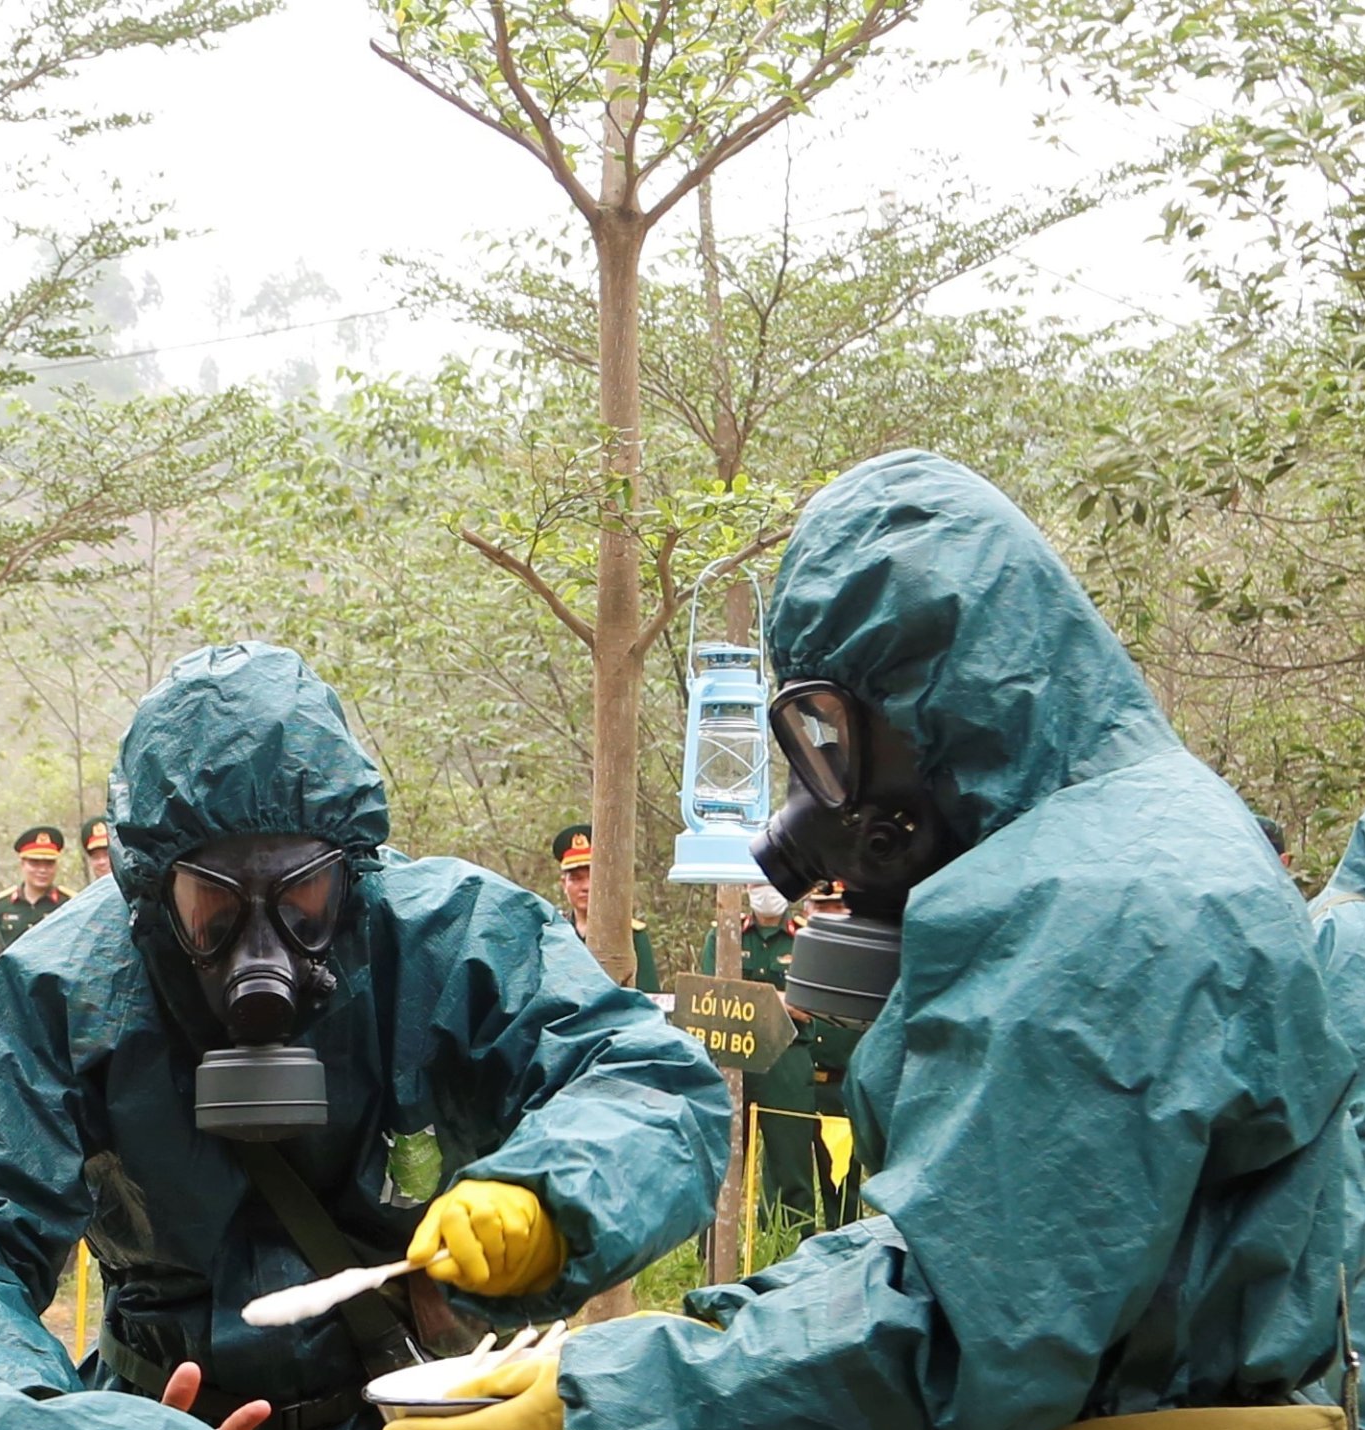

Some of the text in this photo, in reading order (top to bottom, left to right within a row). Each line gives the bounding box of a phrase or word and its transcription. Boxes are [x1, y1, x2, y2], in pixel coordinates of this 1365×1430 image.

[691, 989, 755, 1022] LỐI VÀO
[710, 1030, 727, 1051] ĐI
[730, 1030, 755, 1059] BỘ
